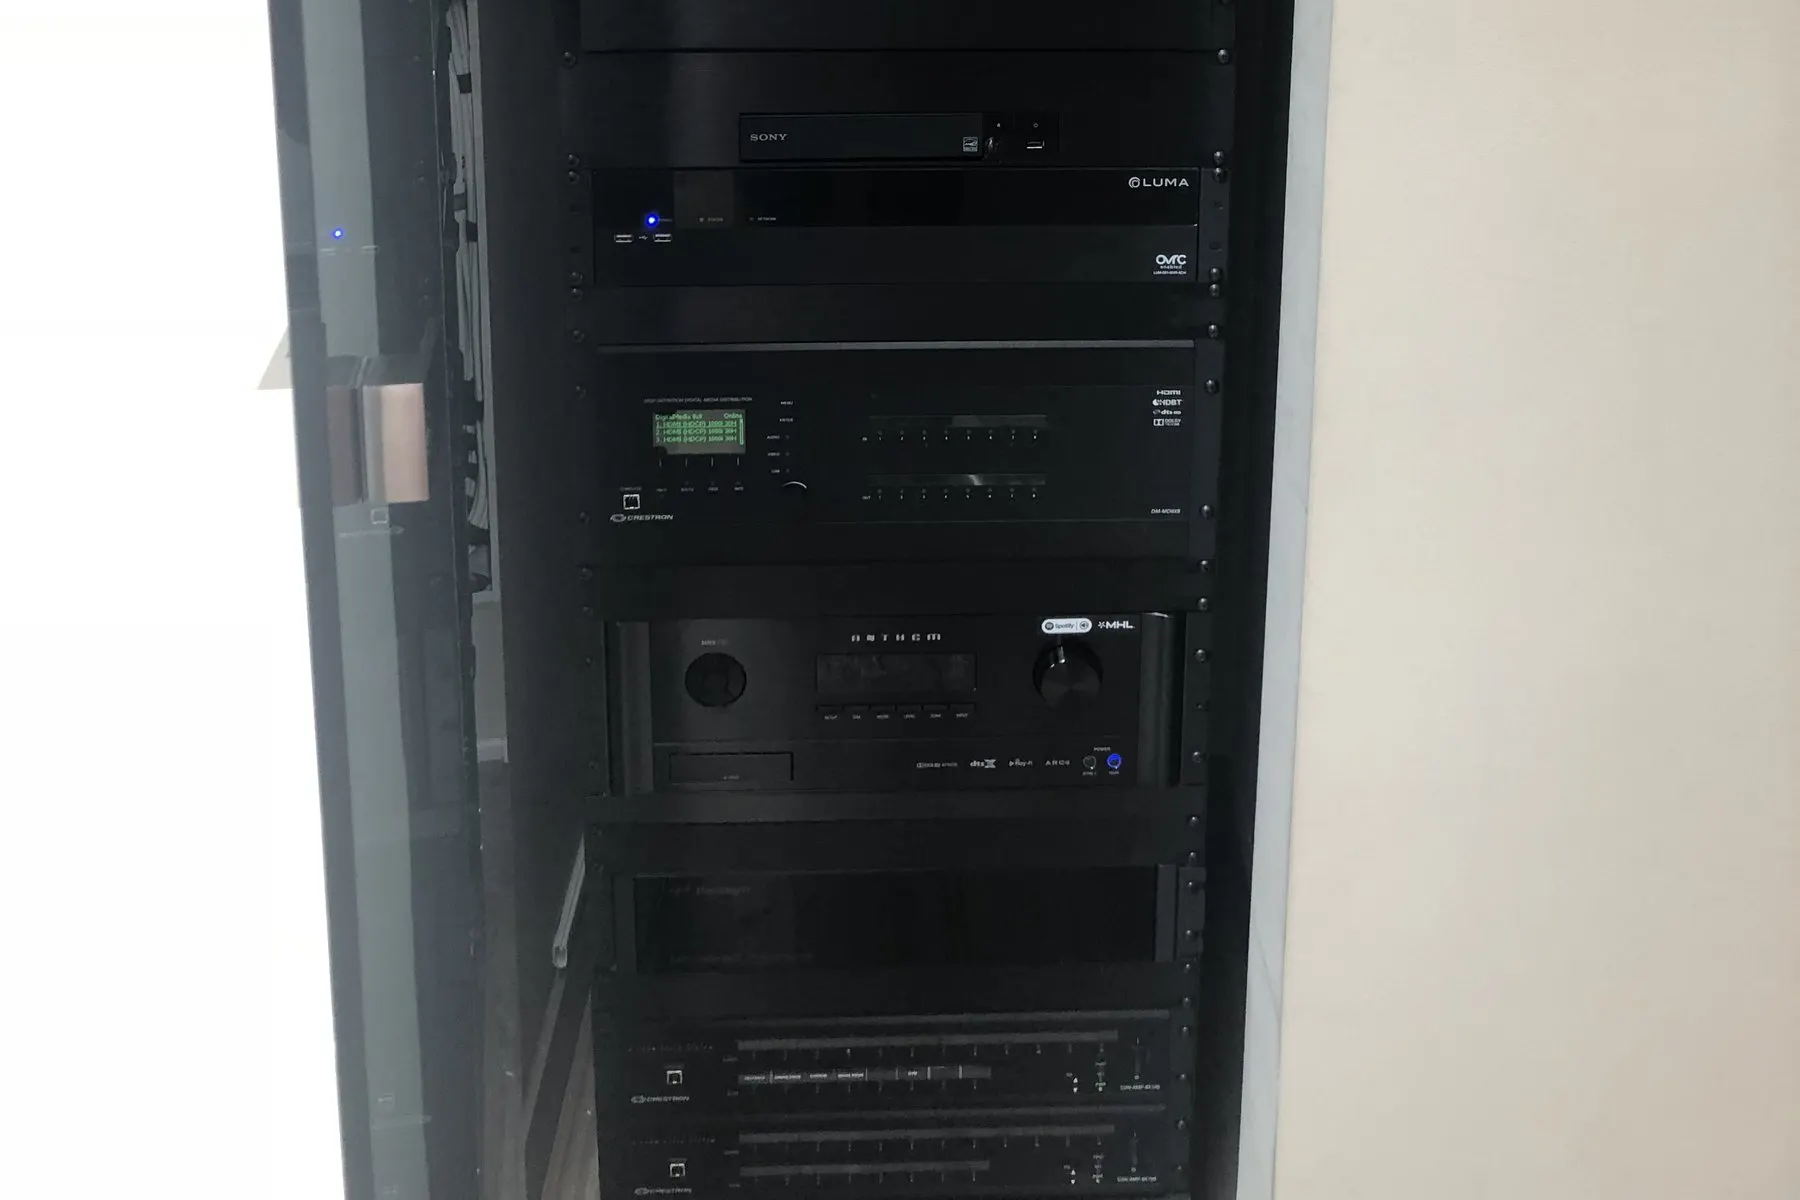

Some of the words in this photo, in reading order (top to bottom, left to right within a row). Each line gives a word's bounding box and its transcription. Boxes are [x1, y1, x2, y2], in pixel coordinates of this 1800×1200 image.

[750, 133, 788, 142] SONY
[1142, 177, 1190, 188] LUMA
[1105, 620, 1134, 629] MHL
